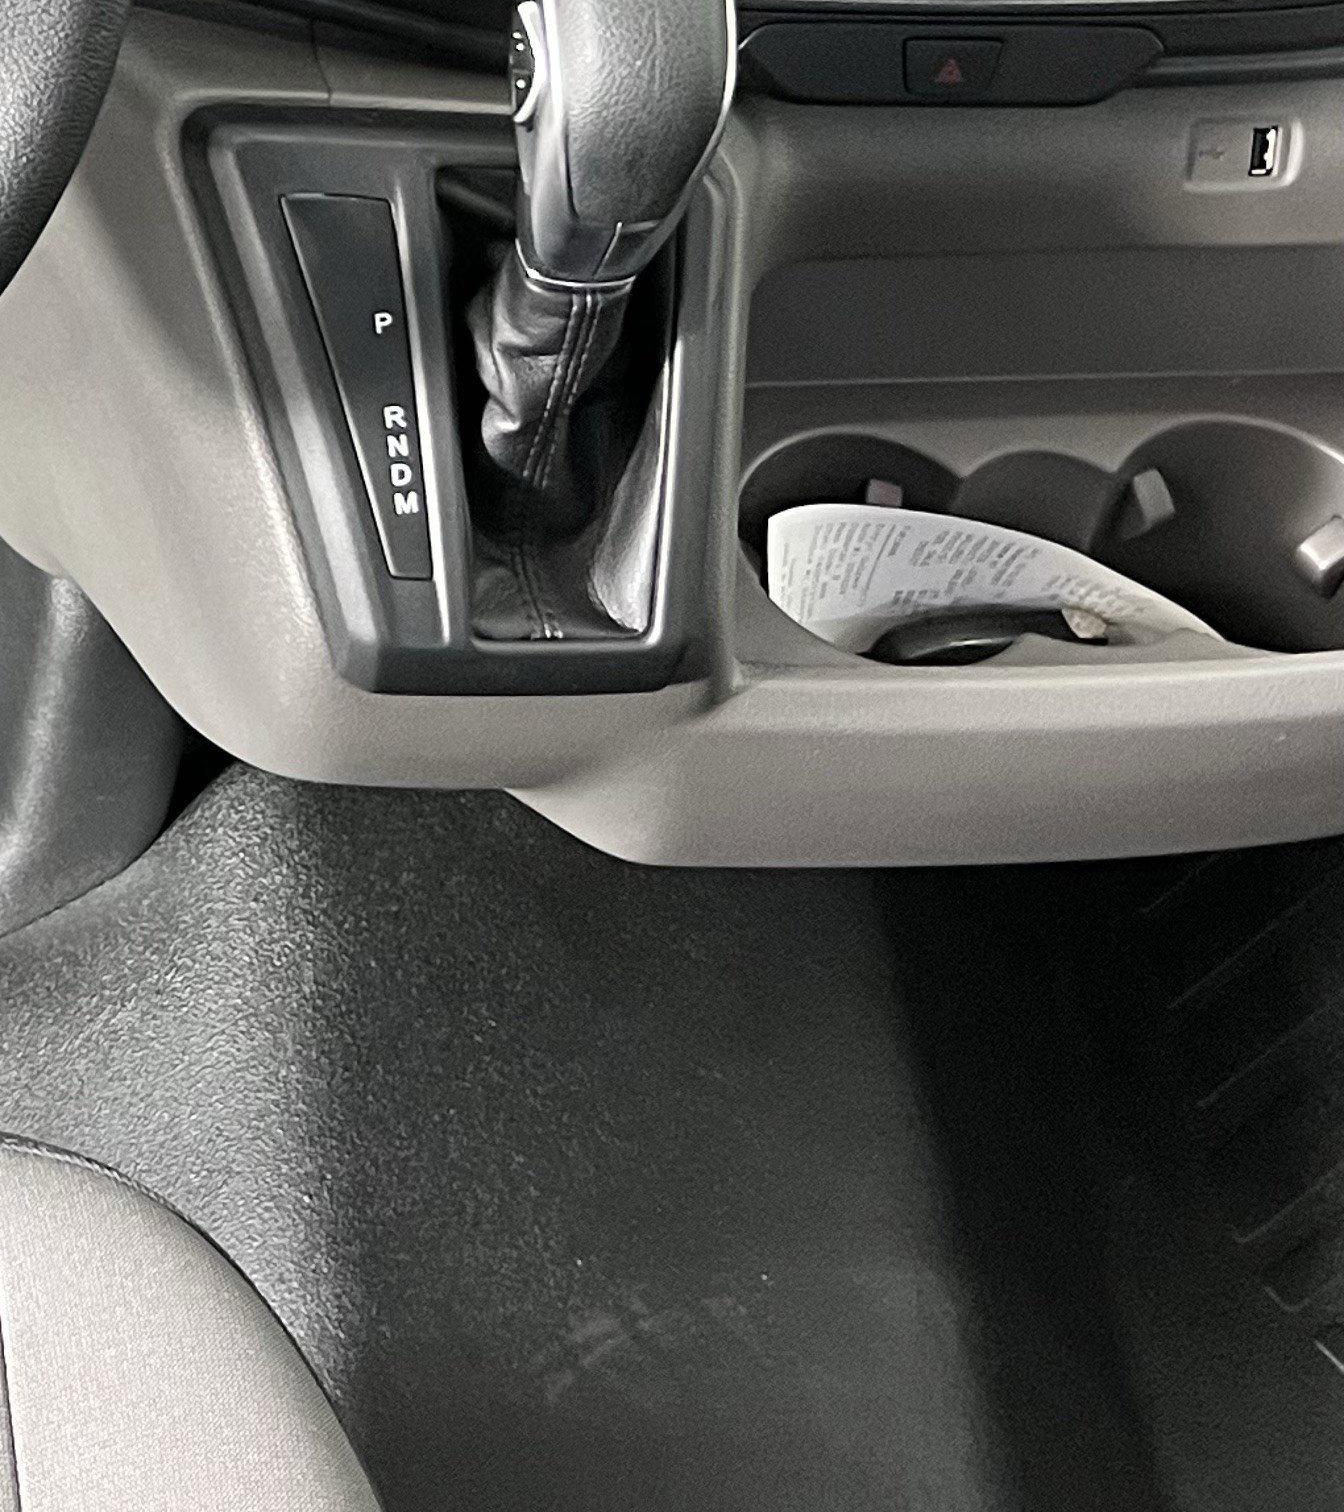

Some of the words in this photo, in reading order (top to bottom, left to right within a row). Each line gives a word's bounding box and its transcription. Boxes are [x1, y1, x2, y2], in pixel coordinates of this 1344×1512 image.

[373, 312, 393, 335] P
[383, 405, 407, 429] R
[386, 434, 410, 457] N
[390, 463, 413, 487] D
[394, 492, 419, 515] M
